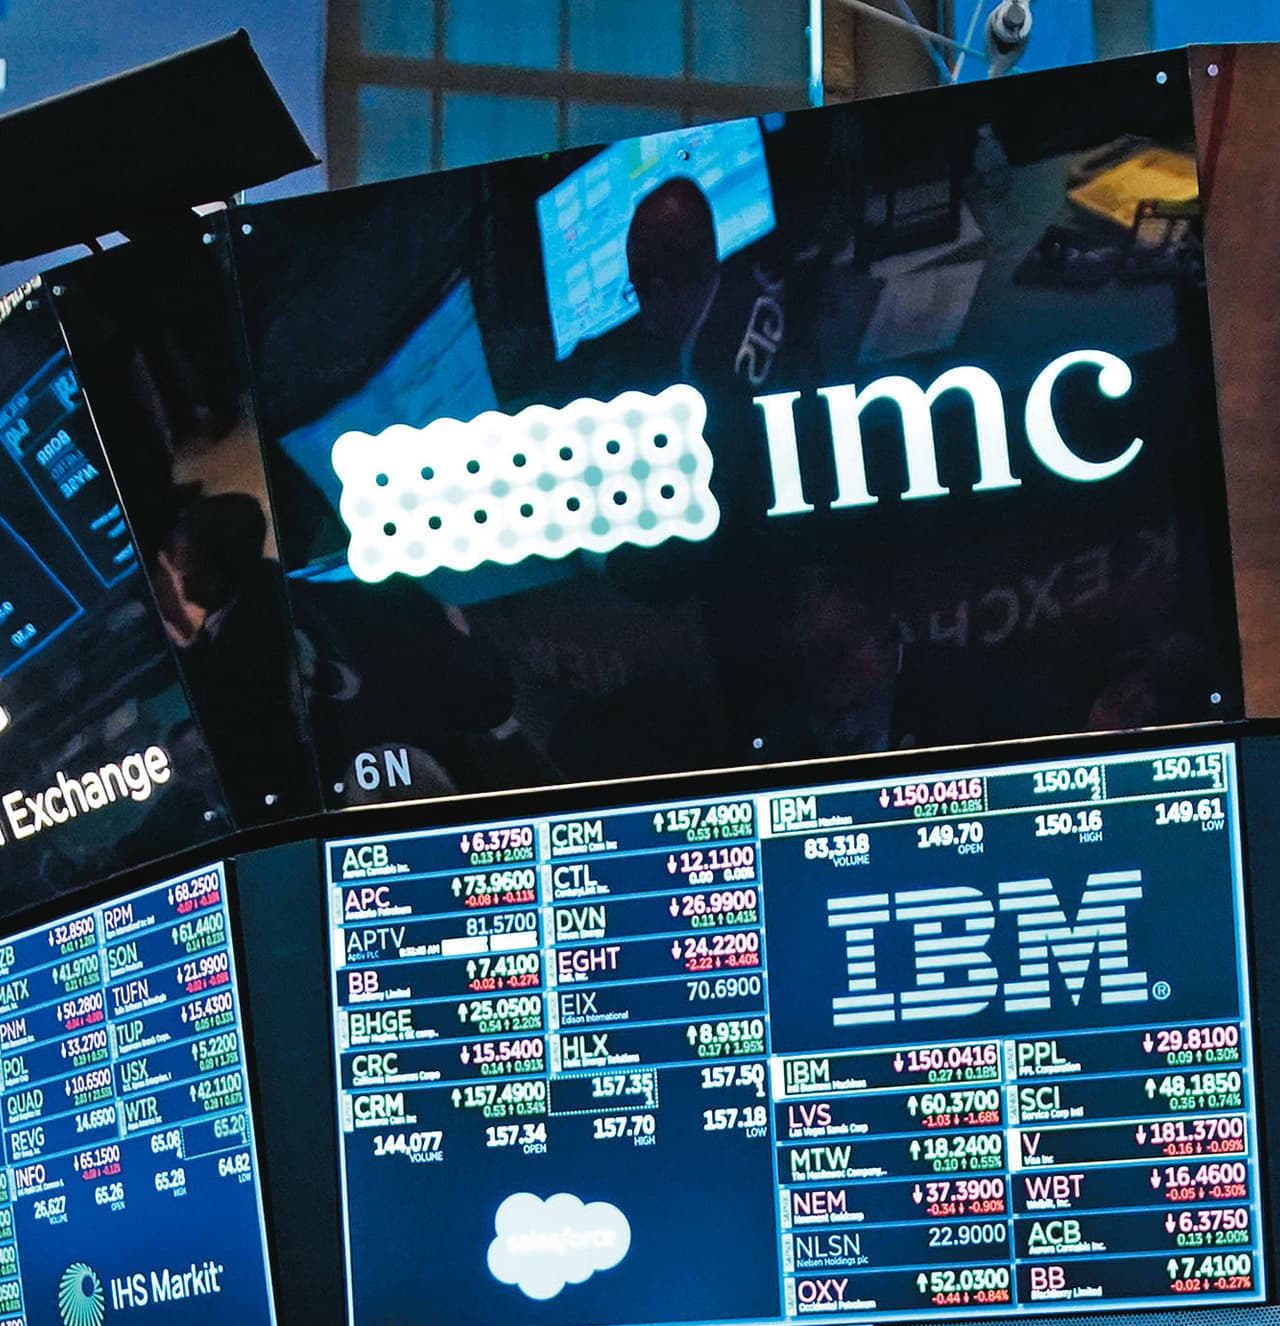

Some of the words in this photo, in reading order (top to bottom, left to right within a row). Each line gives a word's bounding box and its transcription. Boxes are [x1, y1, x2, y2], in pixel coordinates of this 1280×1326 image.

[752, 349, 1145, 517] imc
[2, 745, 172, 839] Exchange
[353, 749, 412, 790] 6N
[772, 796, 816, 824] IBM
[892, 779, 983, 806] 150.0416
[1033, 766, 1101, 791] 150.04
[1152, 754, 1221, 780] 150.15
[343, 845, 389, 870] ACB
[472, 827, 533, 850] 6.3750
[804, 834, 870, 861] 83,318
[917, 823, 984, 848] 149.70
[1035, 811, 1103, 836] 150.16
[1155, 799, 1224, 825] 149.61
[833, 854, 870, 867] VOLUME
[958, 843, 984, 855] OPEN
[1080, 831, 1102, 843] HIGH
[1201, 819, 1224, 832] LOW
[827, 869, 1149, 1026] IBM
[112, 980, 151, 1007] TUFN
[182, 953, 229, 983] 21.9900
[350, 1010, 412, 1036] BHGE
[469, 996, 542, 1021] 25.0500
[354, 1093, 404, 1118] CRM
[464, 1082, 546, 1107] 157.4900
[592, 1074, 654, 1097] 157.35
[701, 1064, 766, 1089] 157.50
[11, 1125, 45, 1154] REVG
[76, 1105, 116, 1134] 14.6500
[374, 1132, 443, 1156] 144,077
[486, 1123, 547, 1147] 157.34
[593, 1115, 656, 1139] 157.70
[704, 1107, 767, 1131] 157.18
[410, 1151, 443, 1162] VOLUME
[523, 1143, 547, 1154] OPEN
[634, 1135, 655, 1146] HIGH
[746, 1126, 767, 1138] LOW
[15, 1159, 46, 1190] INFO
[80, 1145, 121, 1172] 65.1500
[95, 1183, 124, 1206] 65.26
[155, 1168, 186, 1192] 65.28
[218, 1154, 251, 1178] 64.82
[1025, 1174, 1085, 1200] WBT
[1165, 1162, 1245, 1187] 16.4600
[796, 1234, 862, 1259] NLSN
[928, 1224, 1006, 1249] 22.9000
[111, 1275, 149, 1310] IHS
[152, 1265, 221, 1305] Markit
[798, 1278, 849, 1302] OXY
[931, 1268, 1009, 1292] 52.0300
